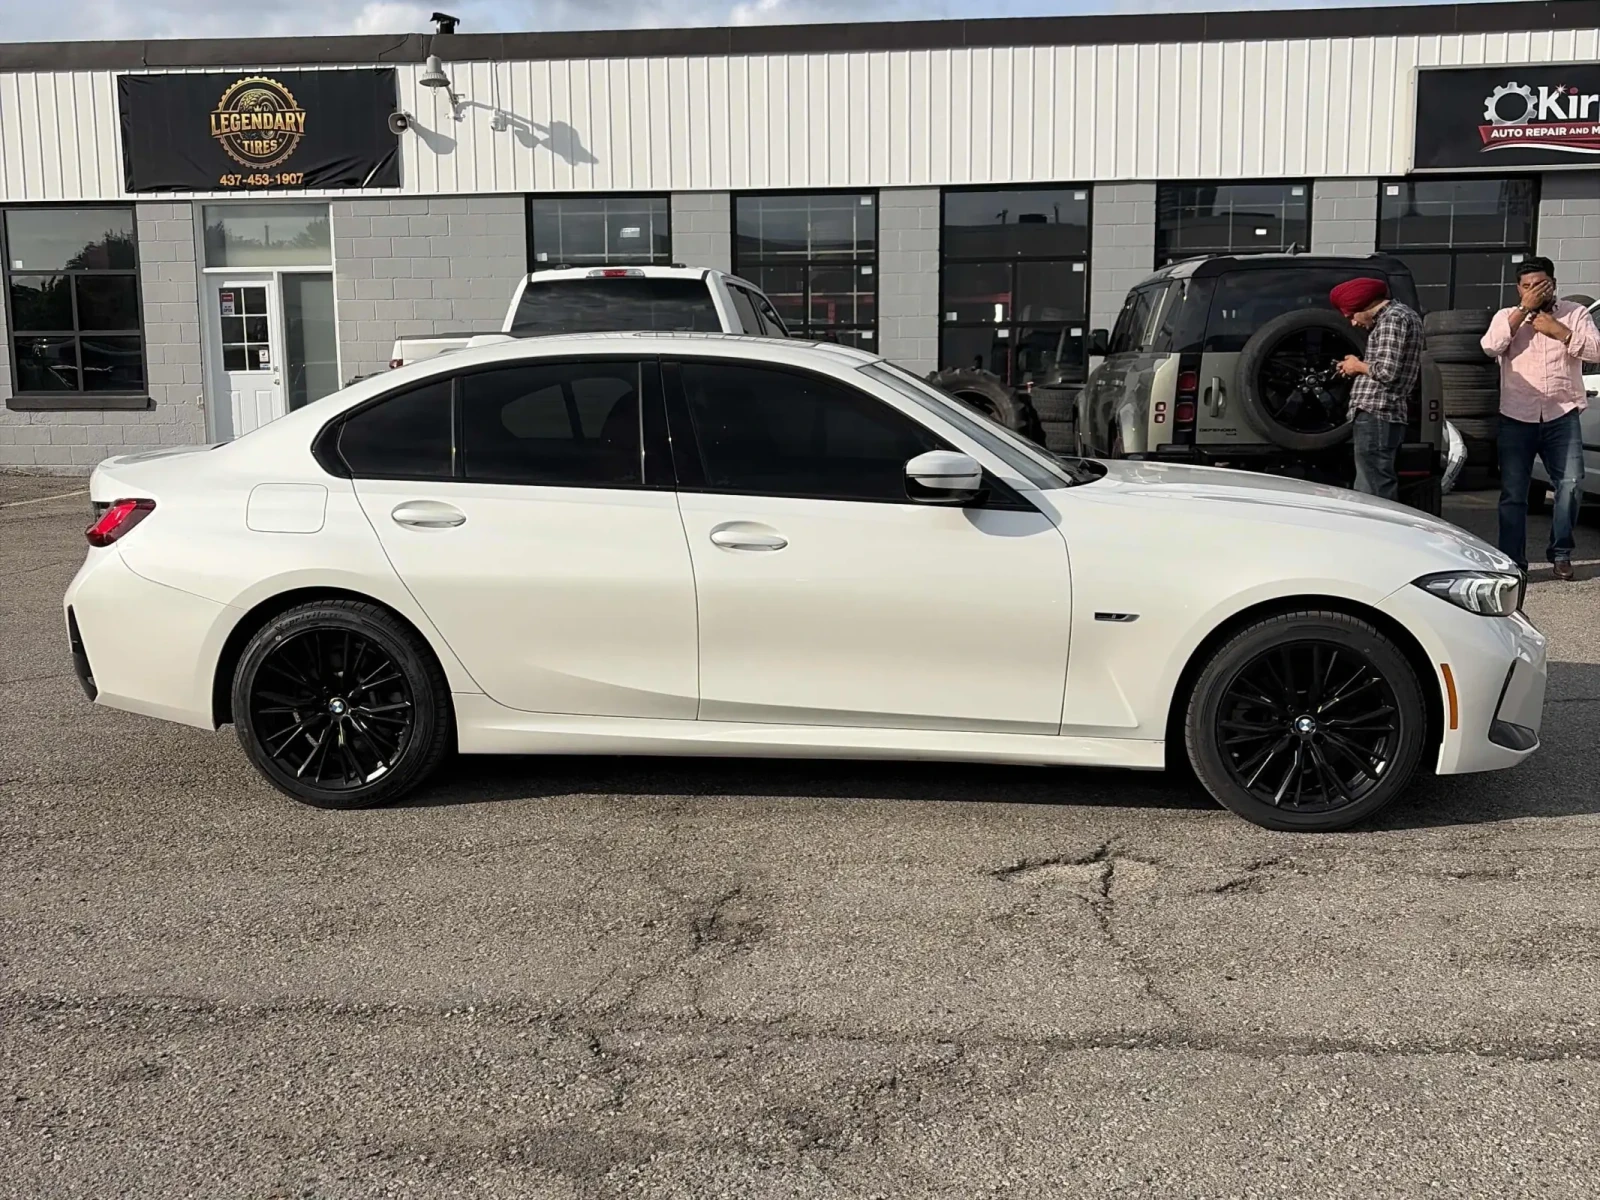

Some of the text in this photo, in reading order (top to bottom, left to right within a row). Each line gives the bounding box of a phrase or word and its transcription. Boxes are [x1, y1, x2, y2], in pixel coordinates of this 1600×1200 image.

[1537, 86, 1600, 122] Kir
[210, 112, 306, 135] LEGENDARY
[1491, 128, 1523, 138] AUTO
[1525, 127, 1567, 137] REPAIR
[1569, 127, 1590, 135] AND
[242, 140, 278, 154] TIRES
[219, 172, 304, 186] 437-453-1907
